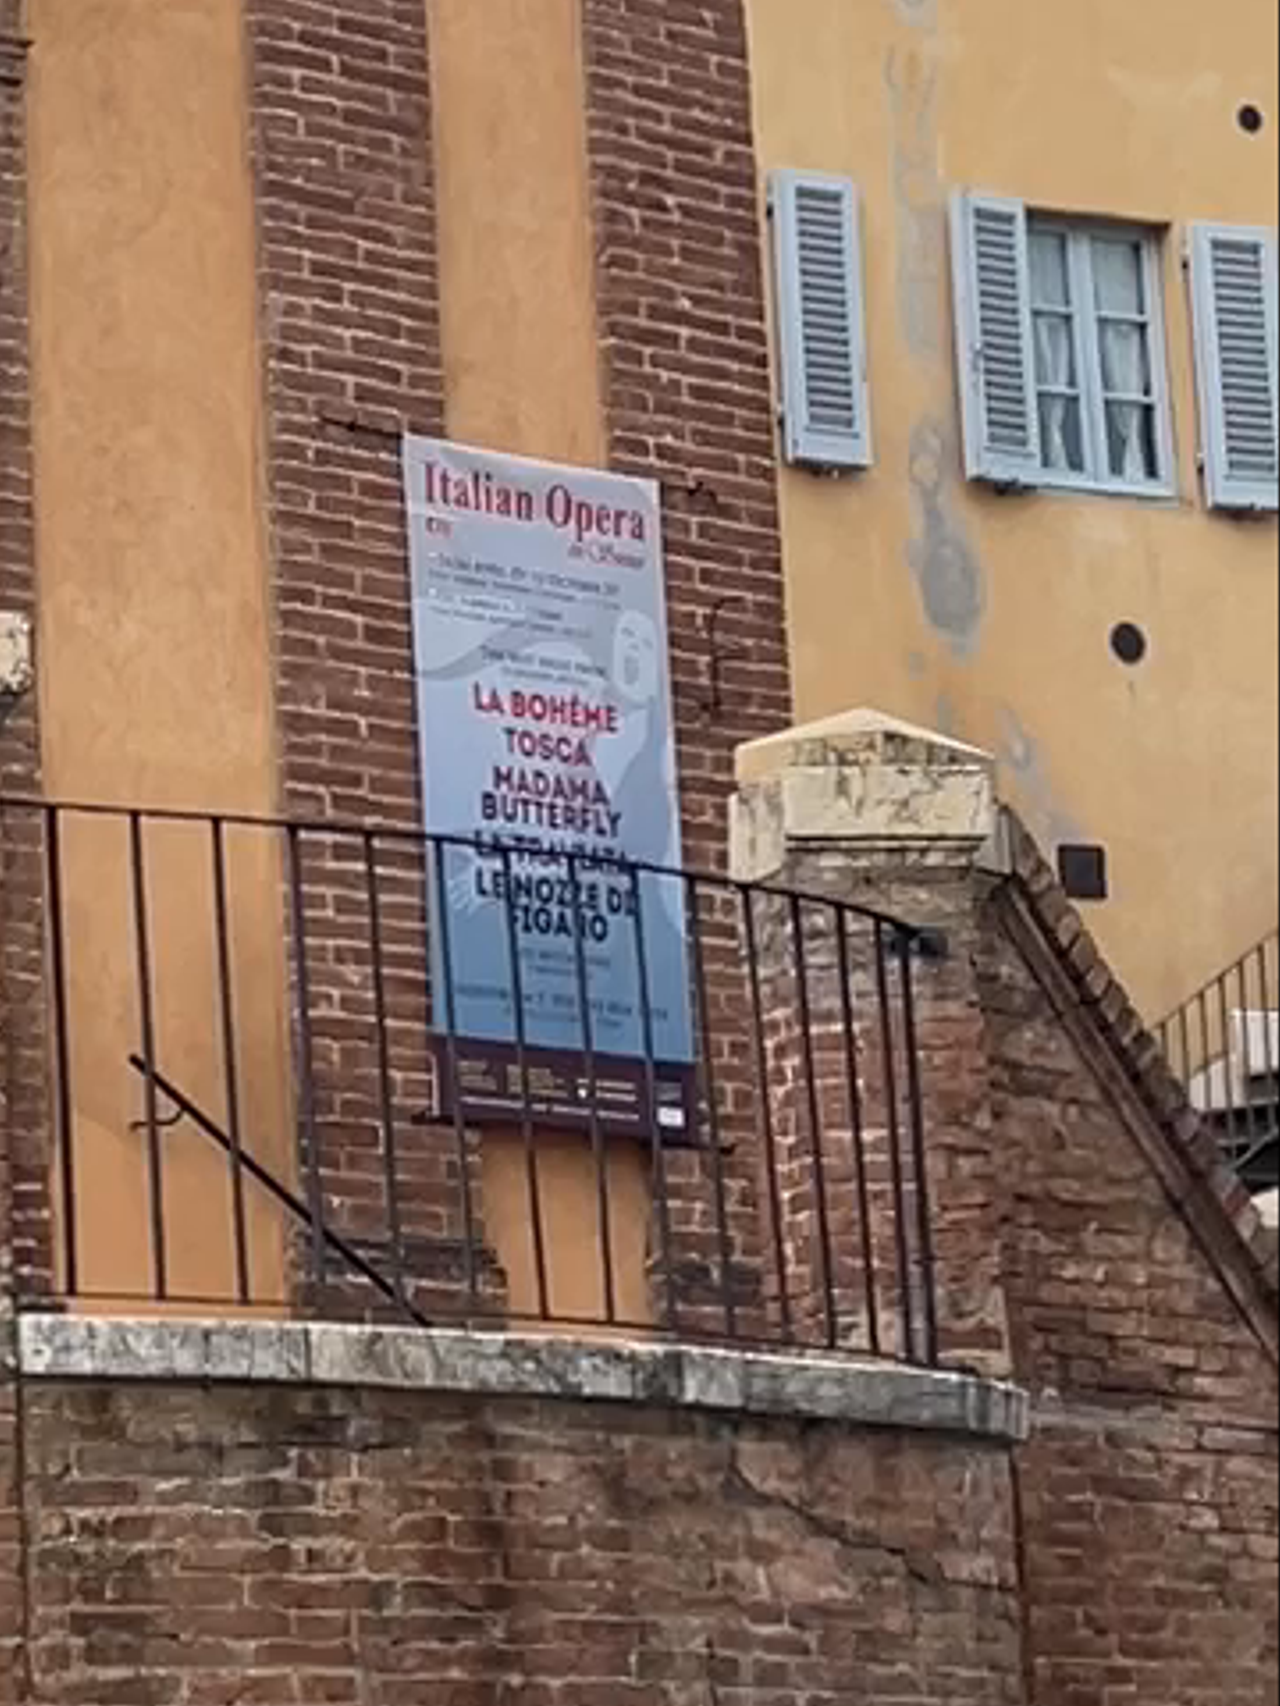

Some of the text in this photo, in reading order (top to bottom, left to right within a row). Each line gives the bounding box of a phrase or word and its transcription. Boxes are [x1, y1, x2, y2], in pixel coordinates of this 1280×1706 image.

[424, 461, 646, 542] Italian Opera
[474, 679, 505, 715] LA
[503, 726, 594, 768] TOSCA
[493, 765, 611, 807] MADAMA
[481, 791, 622, 839] BUTTERFLY
[475, 866, 507, 899] LE
